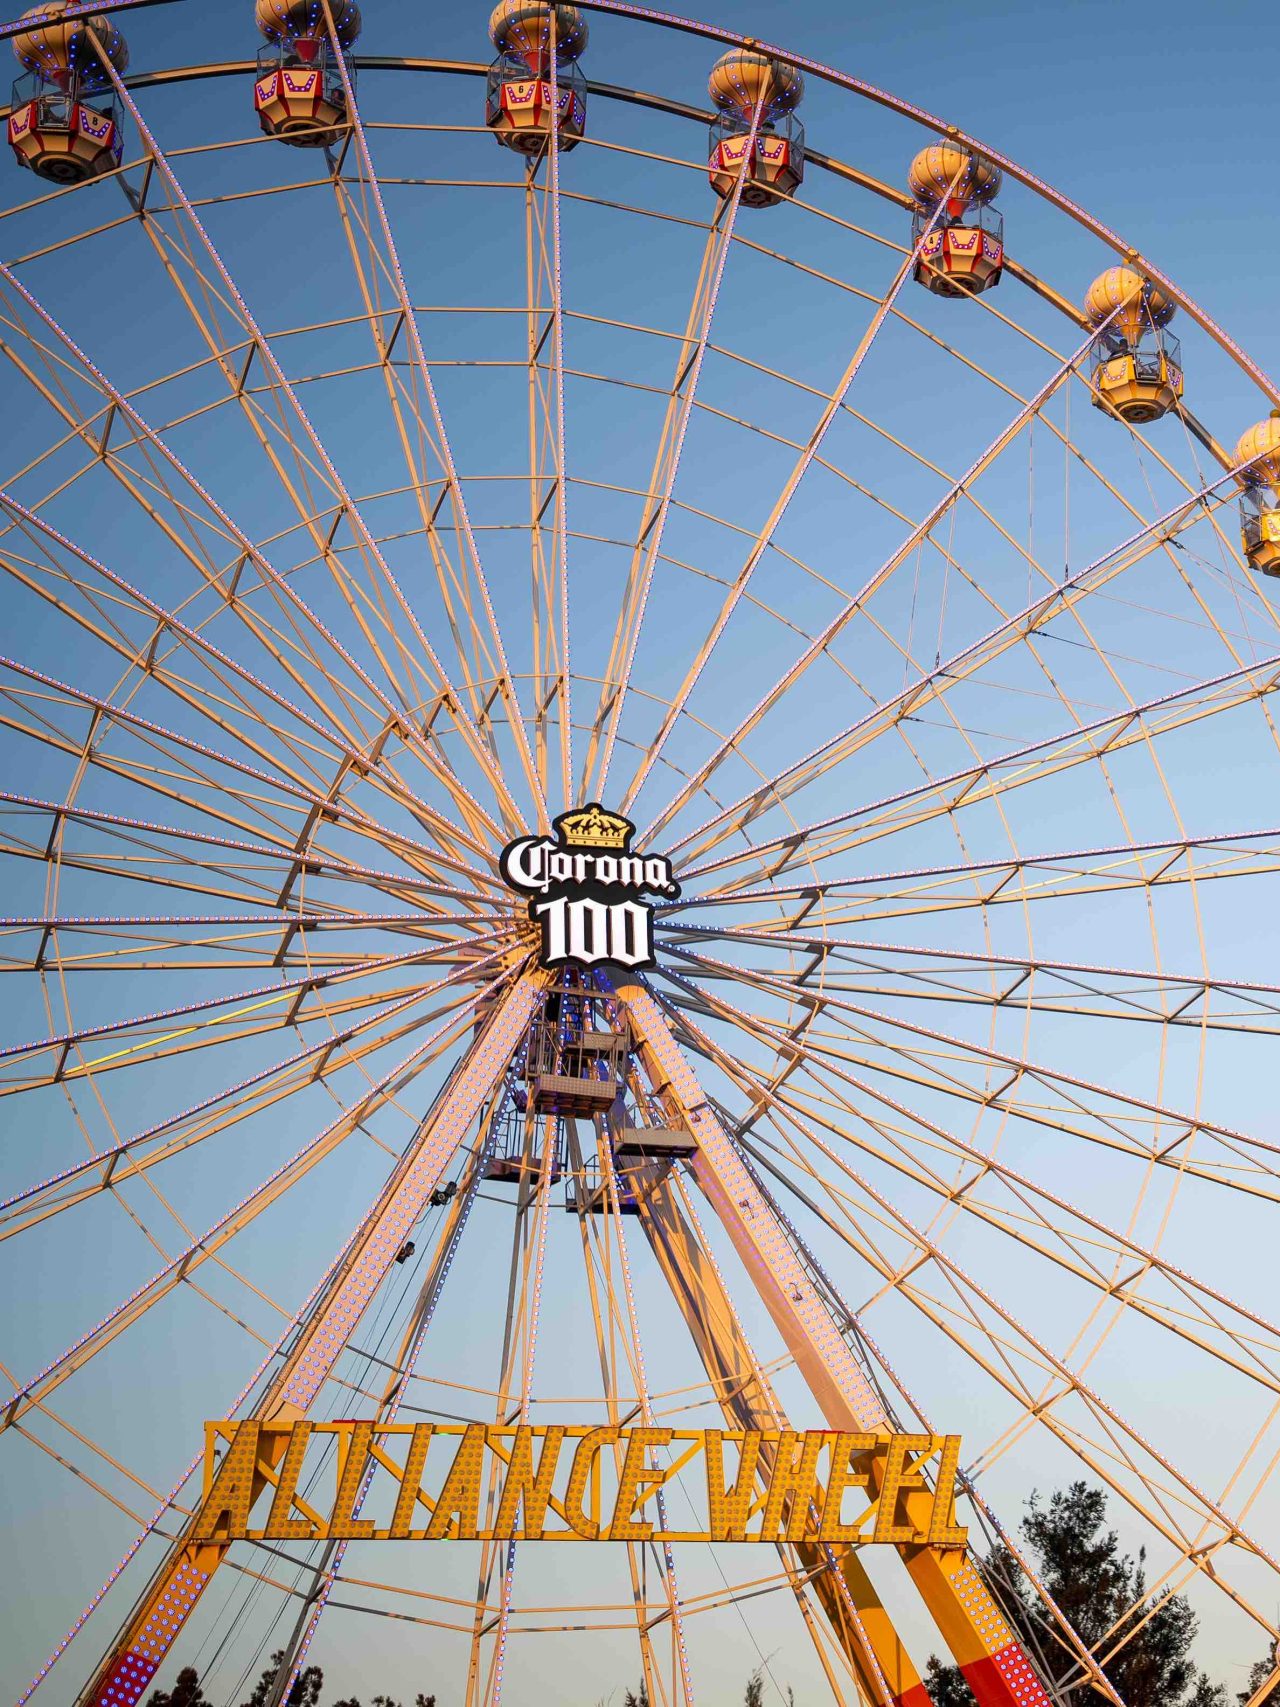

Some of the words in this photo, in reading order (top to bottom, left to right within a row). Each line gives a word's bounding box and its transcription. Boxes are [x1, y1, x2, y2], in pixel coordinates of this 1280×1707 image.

[518, 85, 524, 94] 6
[92, 116, 98, 126] 8
[507, 840, 670, 893] Corona
[536, 897, 652, 966] 100
[192, 1419, 673, 1541] ALLIANCE
[704, 1428, 969, 1543] WHEEL
